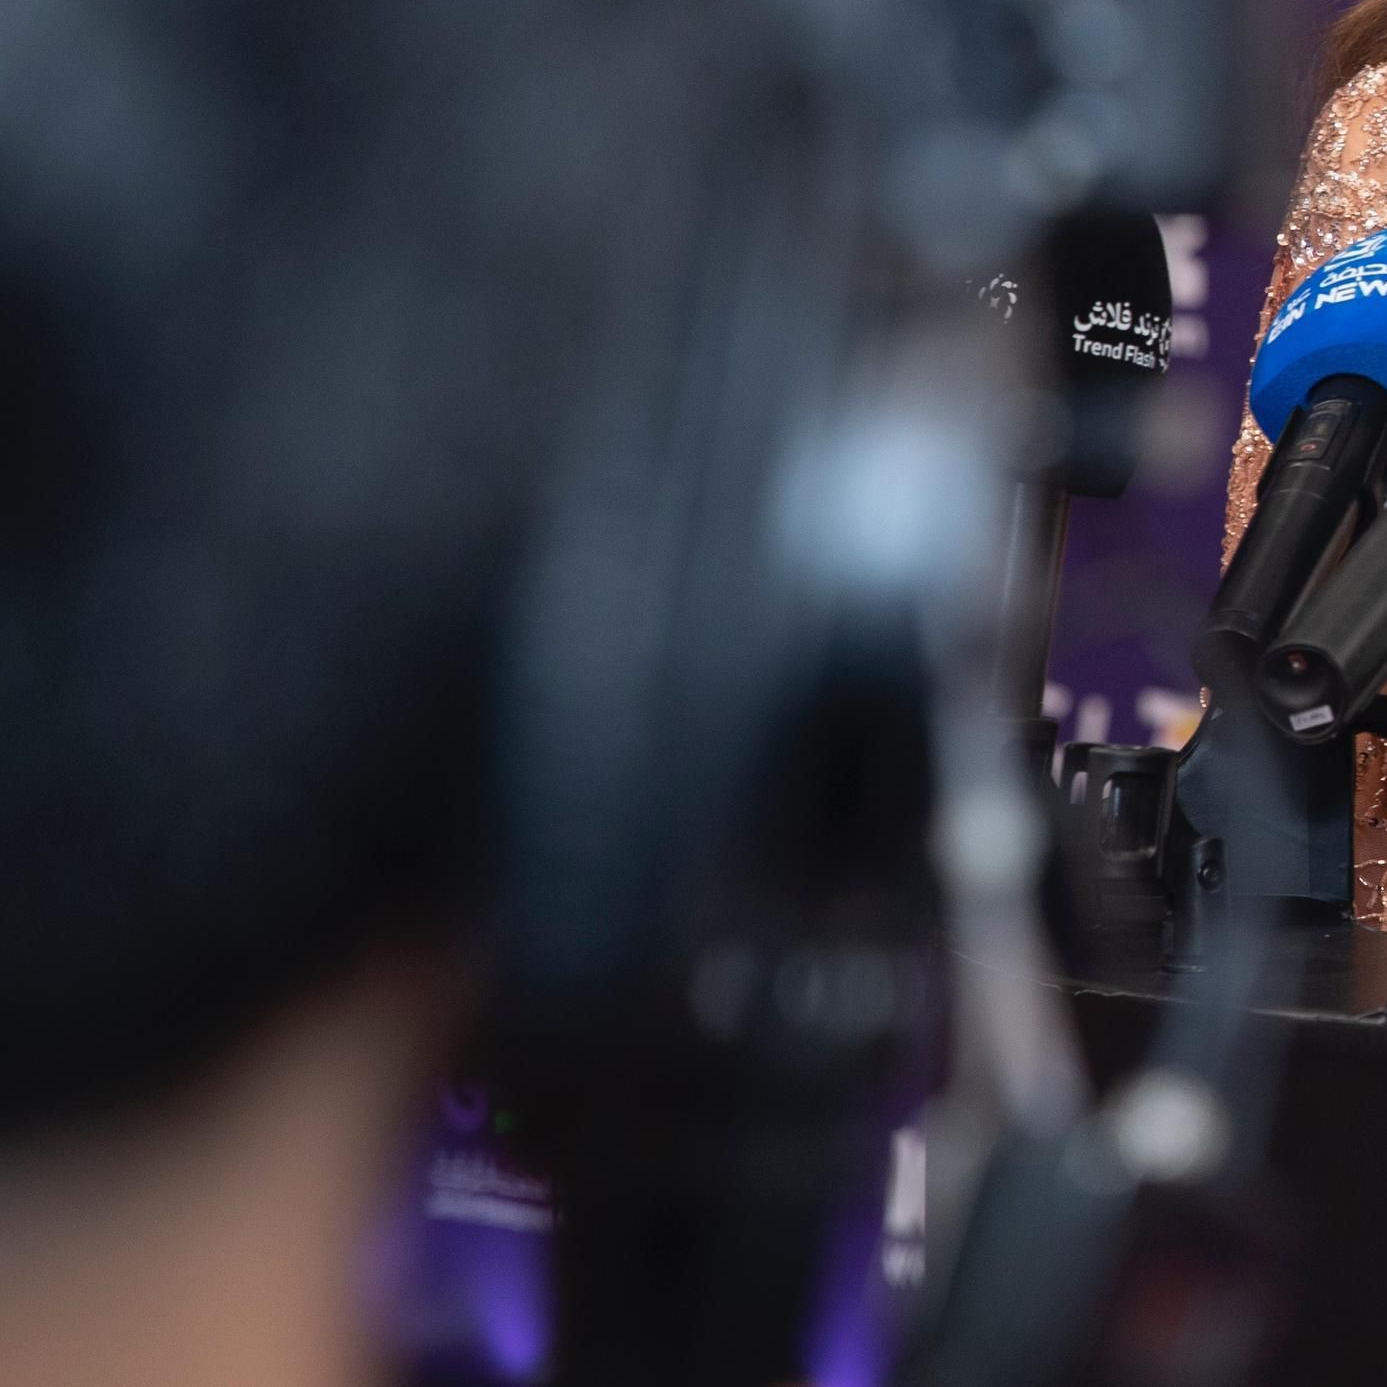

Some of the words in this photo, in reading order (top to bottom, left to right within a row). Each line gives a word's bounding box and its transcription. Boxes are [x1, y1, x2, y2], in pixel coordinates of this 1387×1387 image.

[1074, 300, 1132, 332] فلاش
[1134, 312, 1160, 346] ترند
[1072, 333, 1124, 361] Trend
[1124, 344, 1156, 370] Flash
